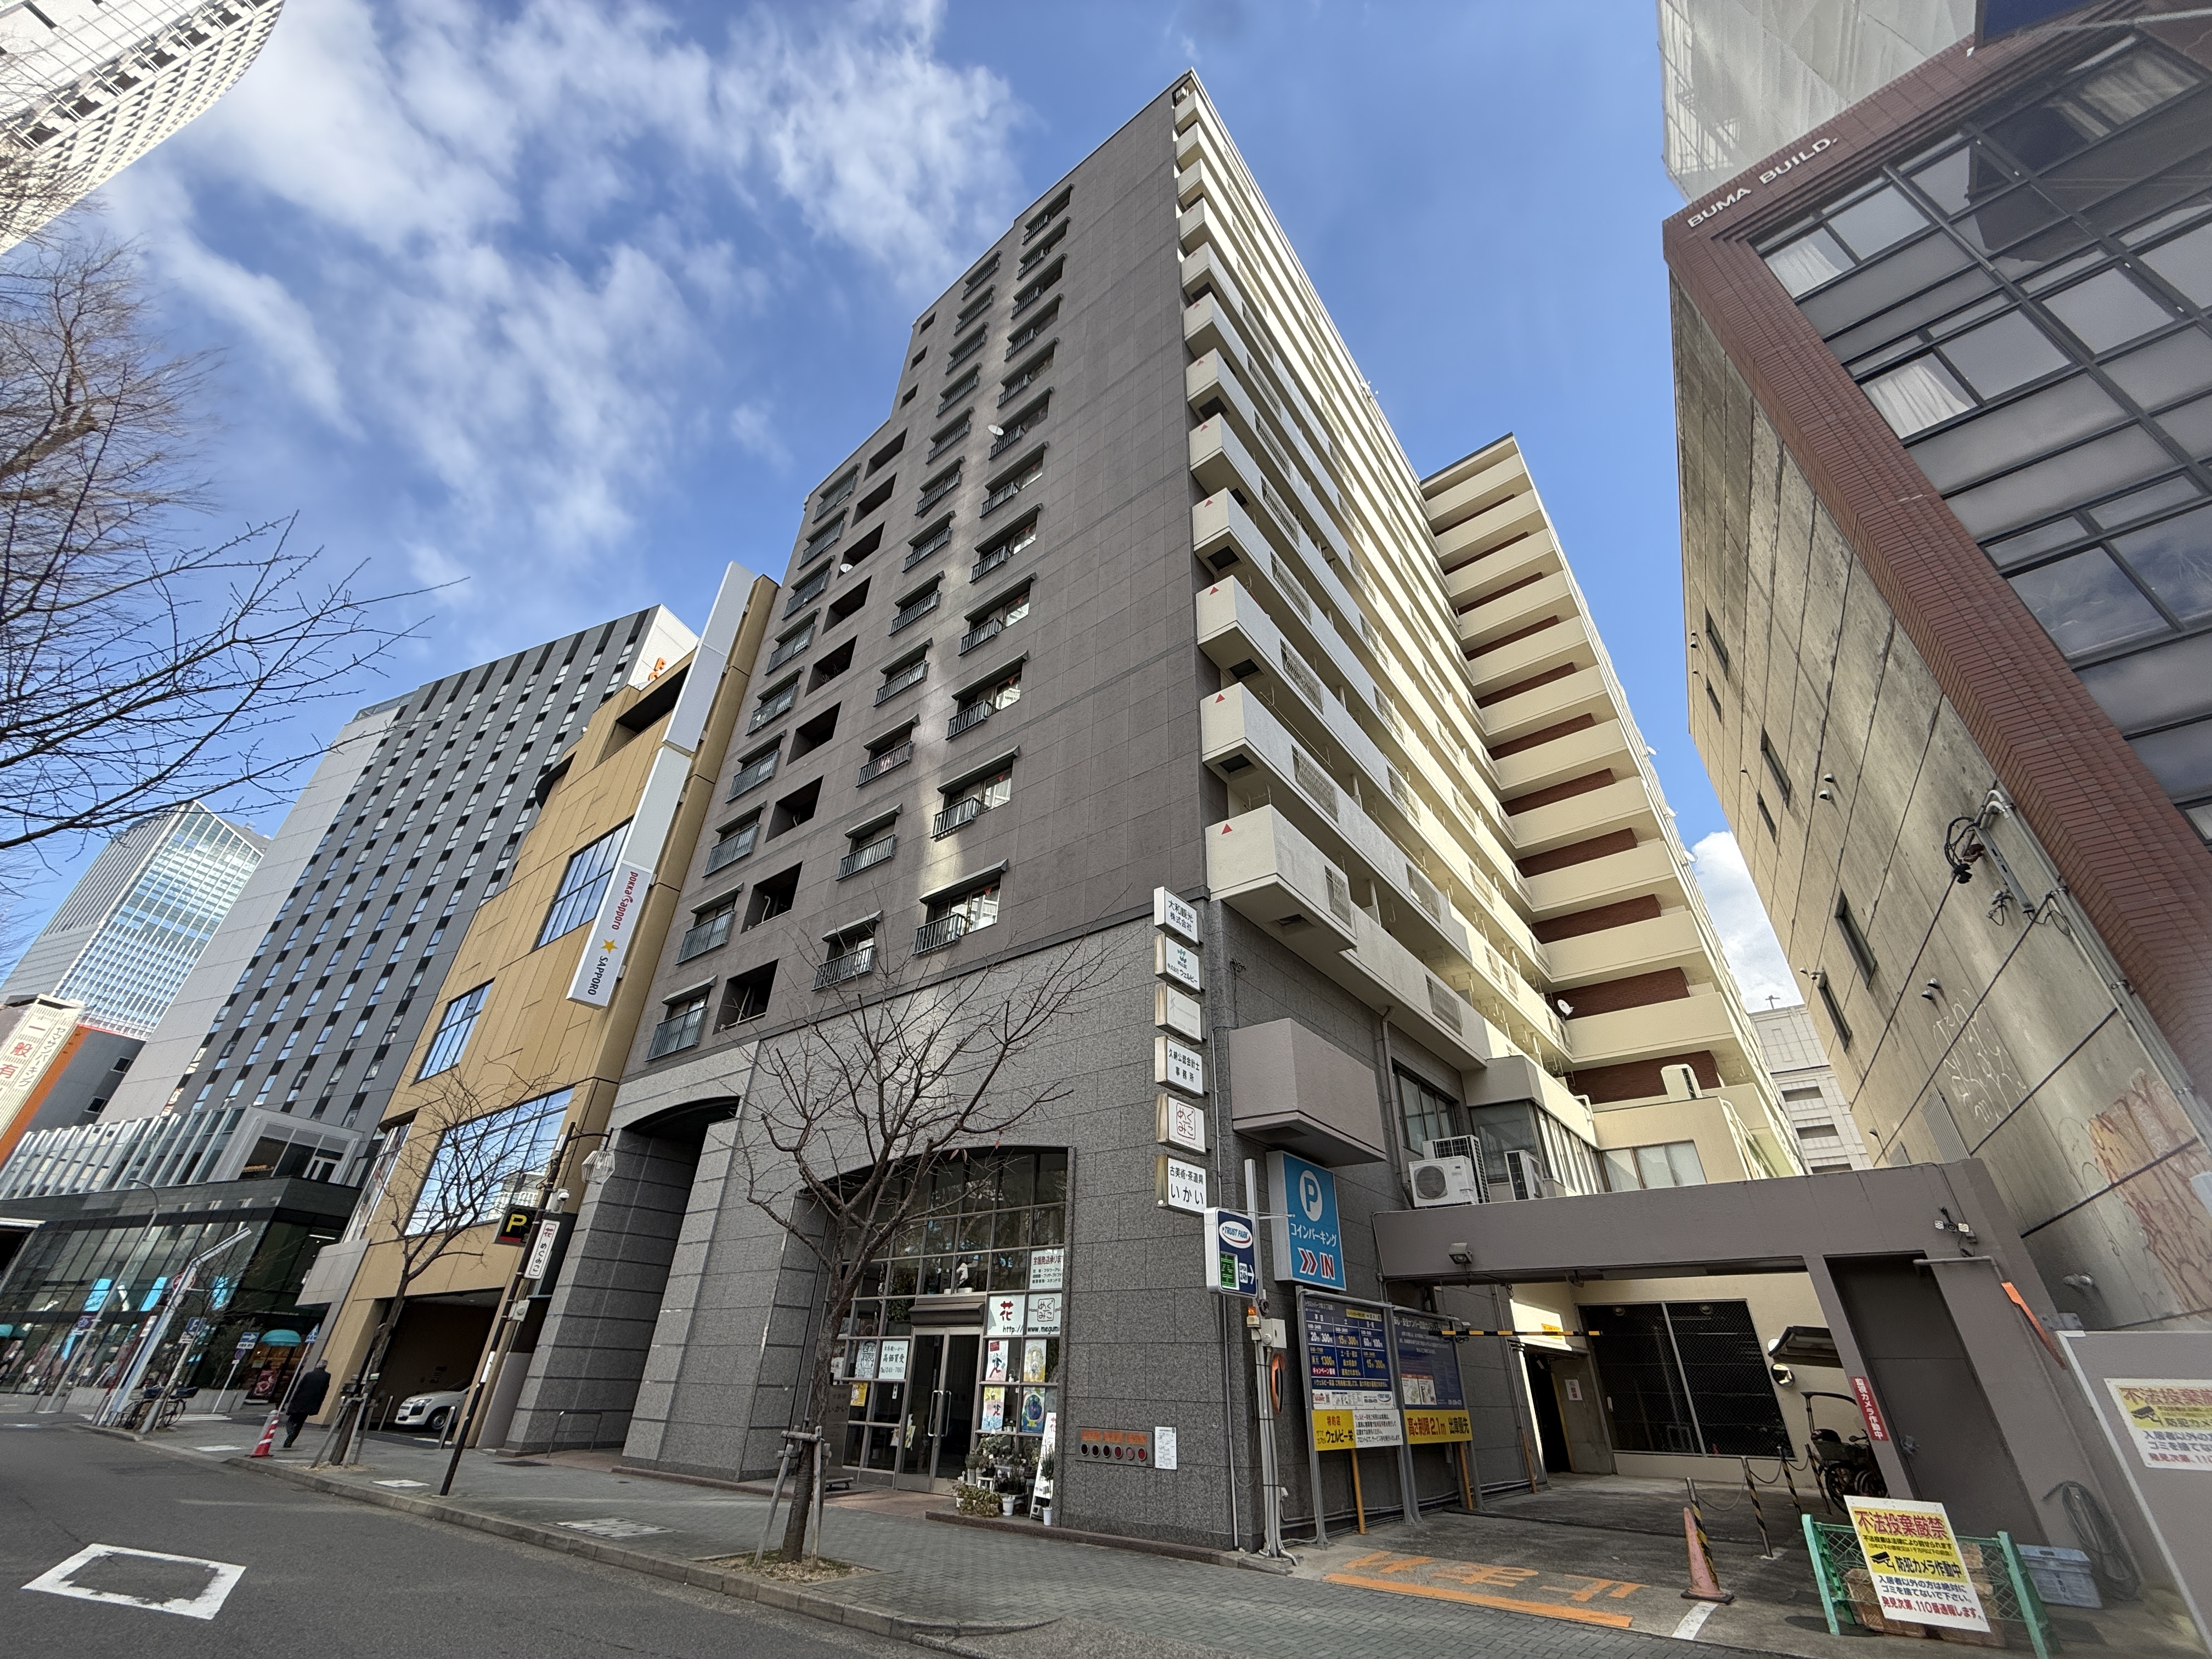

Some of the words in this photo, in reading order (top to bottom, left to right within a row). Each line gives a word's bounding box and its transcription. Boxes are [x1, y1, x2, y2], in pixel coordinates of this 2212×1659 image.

[1687, 187, 1752, 228] BUMA
[1758, 137, 1838, 184] BUILD.
[1168, 900, 1194, 923] 大和観光
[1170, 912, 1192, 933] 株式会社
[588, 956, 608, 996] SAPPORO
[1180, 969, 1198, 984] ウェルビー
[0, 1025, 46, 1093] 一般有
[18, 1026, 66, 1088] ヤマサンパーキング
[1170, 1165, 1204, 1185] 古美術・茶道具
[1171, 1183, 1204, 1205] いかい
[1304, 1176, 1318, 1212] P
[505, 1214, 527, 1233] P
[543, 1227, 554, 1238] 花
[1224, 1226, 1238, 1235] TRUST
[1237, 1229, 1248, 1239] PARK
[1290, 1222, 1337, 1247] コインパーキング
[1319, 1251, 1335, 1280] IN
[999, 1300, 1014, 1322] 花
[1002, 1324, 1024, 1335] http://
[1854, 1378, 1884, 1441] 監視カメラ作動中
[1407, 1417, 1446, 1437] 高さ制限2.1m
[1448, 1416, 1470, 1435] 出庫優先
[2164, 1418, 2212, 1427] 防犯カメ
[1325, 1429, 1353, 1444] ウェルビー栄
[2143, 1430, 2212, 1441] 入居者以外の
[1854, 1510, 1948, 1539] 不法投棄厳禁
[1894, 1556, 1962, 1578] 防犯カメラ作動中
[1878, 1575, 1967, 1593] 入居者以外の方は絶対に
[1882, 1585, 1972, 1603] ゴミを捨てないで下さい。
[1881, 1596, 1982, 1621] 発見次第、110番通報します。
